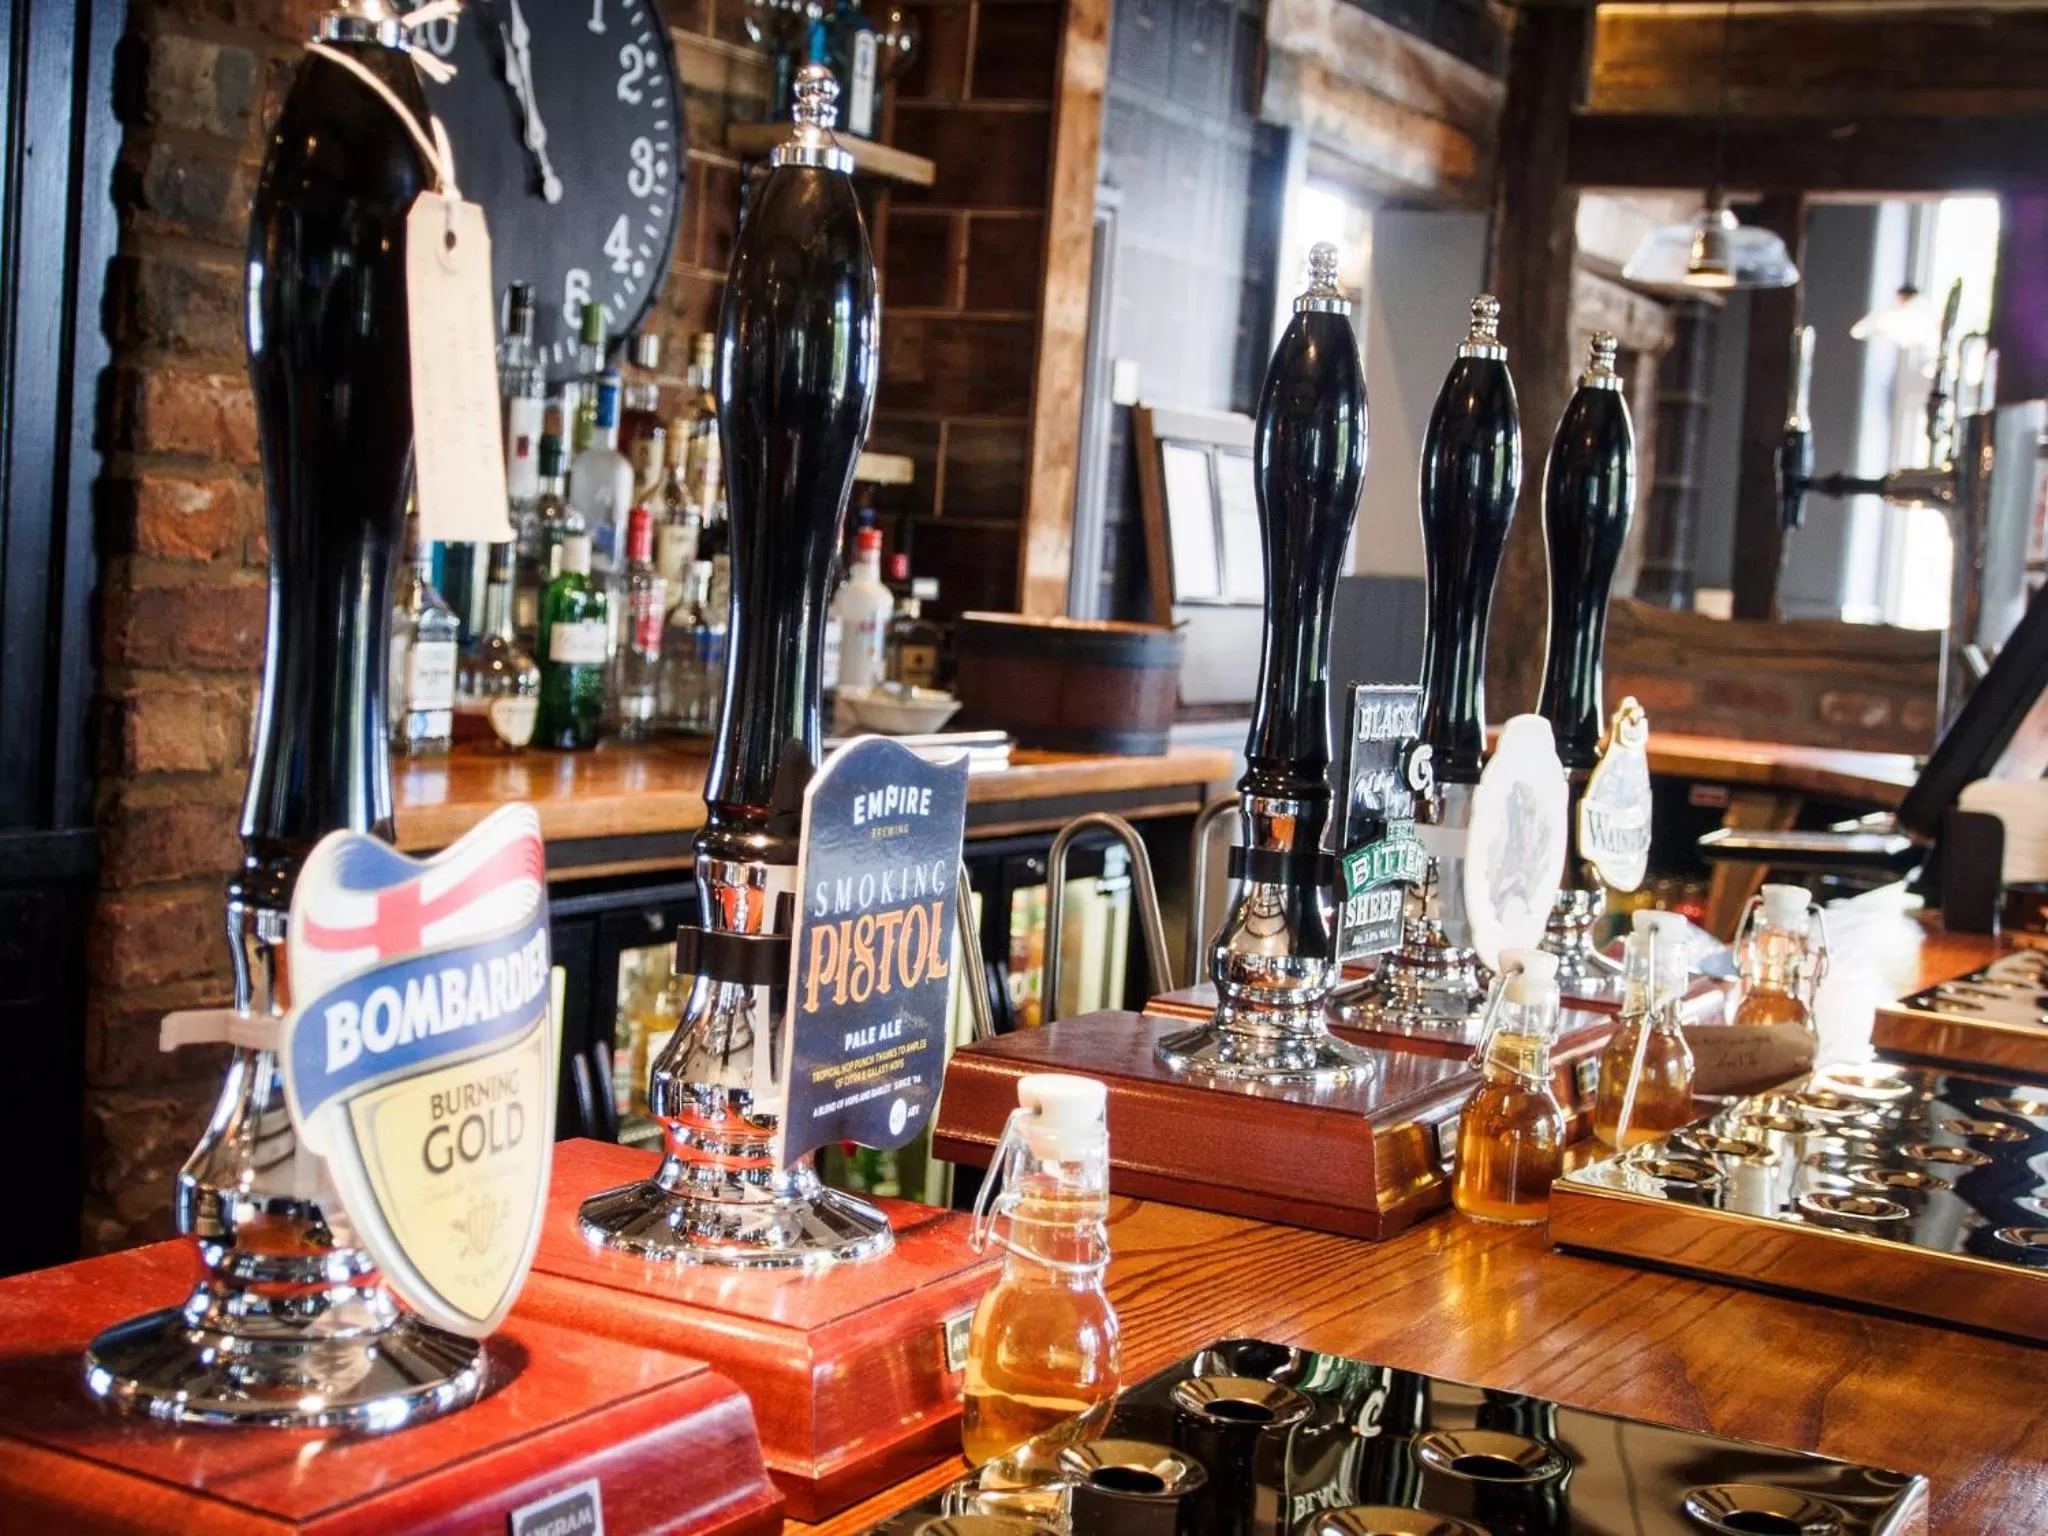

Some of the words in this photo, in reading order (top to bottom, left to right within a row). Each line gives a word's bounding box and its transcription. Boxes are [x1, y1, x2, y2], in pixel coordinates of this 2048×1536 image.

[617, 43, 645, 106] 2
[628, 136, 655, 198] 3
[603, 213, 634, 273] 4
[1358, 703, 1419, 741] BLACK
[853, 784, 933, 826] EMPIRE
[814, 860, 947, 917] SMOKING
[1351, 840, 1428, 890] BITTER
[1344, 889, 1401, 929] SHEEP
[802, 901, 950, 1013] PISTOL
[844, 1027, 877, 1051] PALE
[878, 1018, 903, 1042] ALE
[430, 1068, 521, 1121] BURNING
[422, 1101, 526, 1175] GOLD
